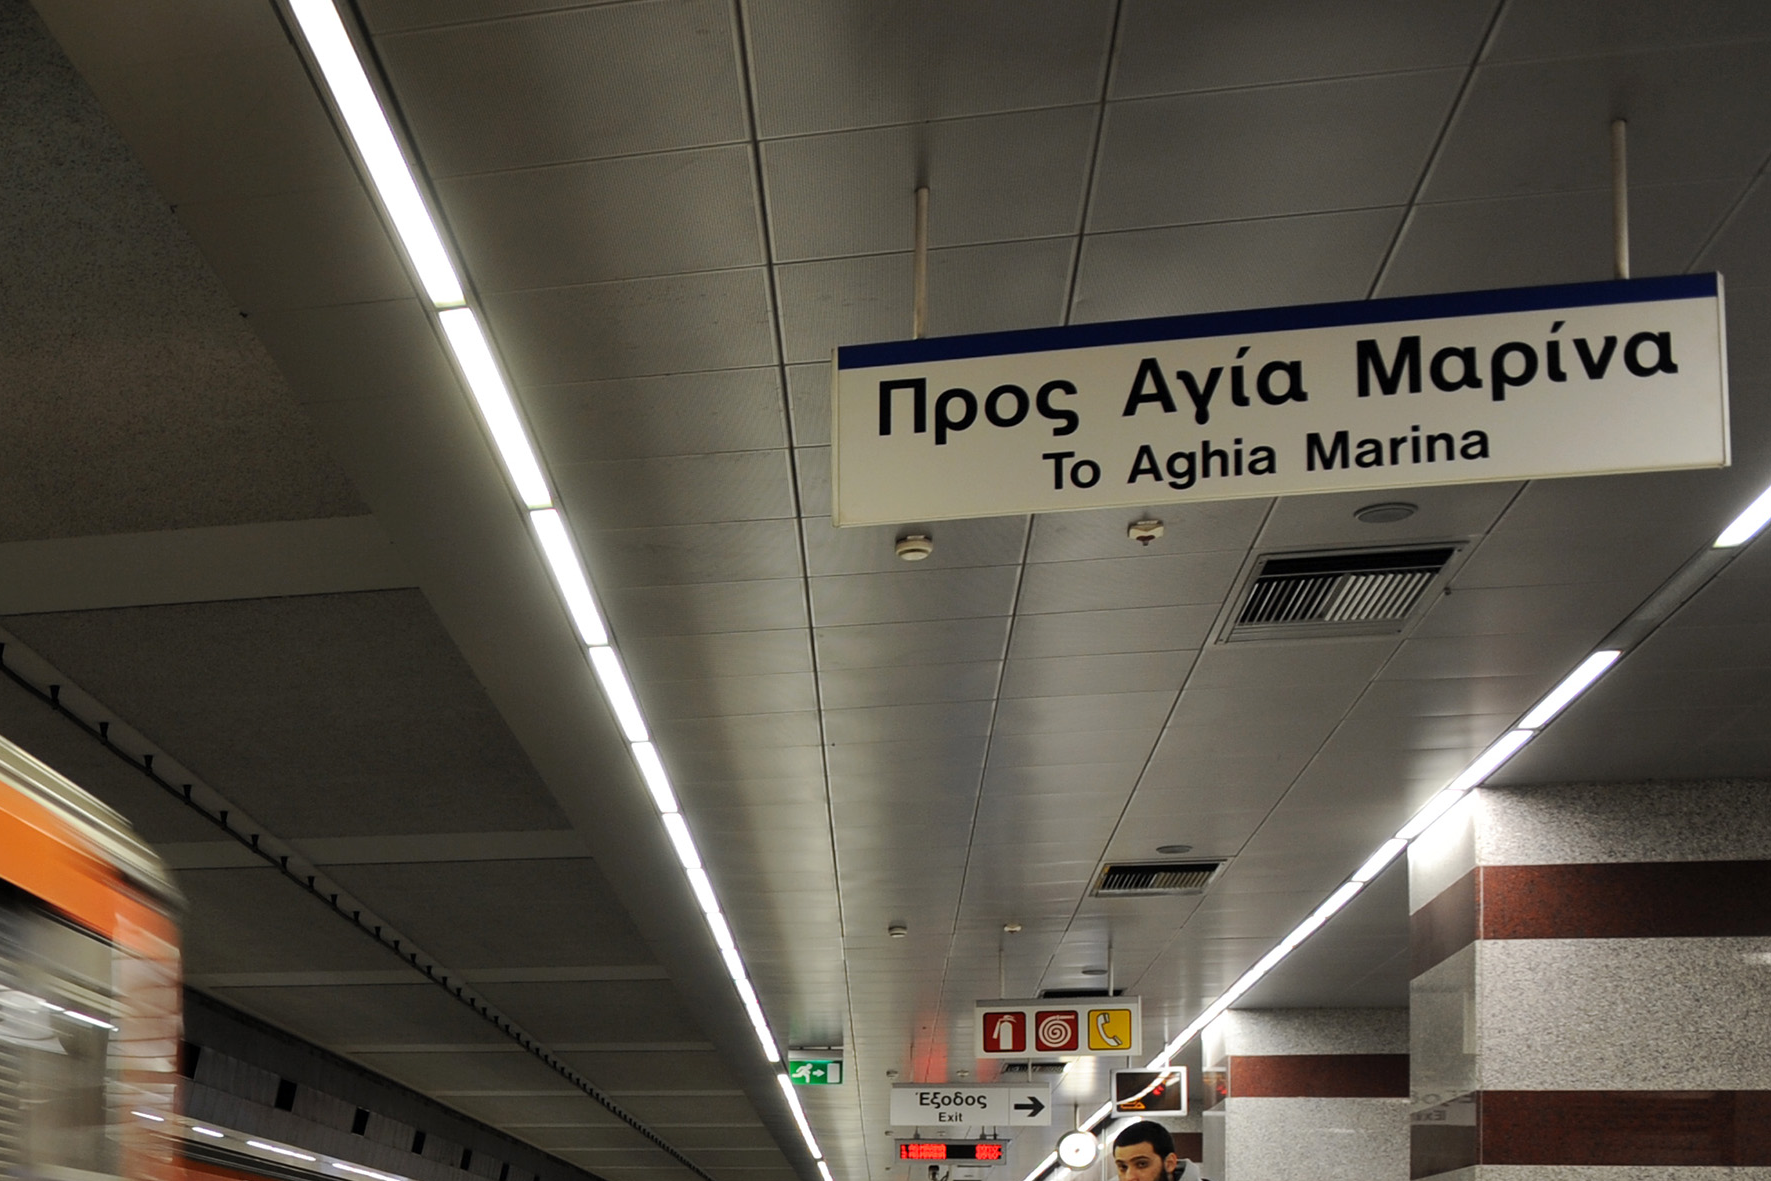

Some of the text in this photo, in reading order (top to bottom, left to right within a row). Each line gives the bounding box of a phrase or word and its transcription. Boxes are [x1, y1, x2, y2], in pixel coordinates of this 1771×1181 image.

[878, 320, 1679, 446] Προς Αγία Μαρίνα
[1042, 424, 1490, 490] To Aghia Marina
[915, 1091, 988, 1109] Έξοδος
[938, 1112, 964, 1122] Exit
